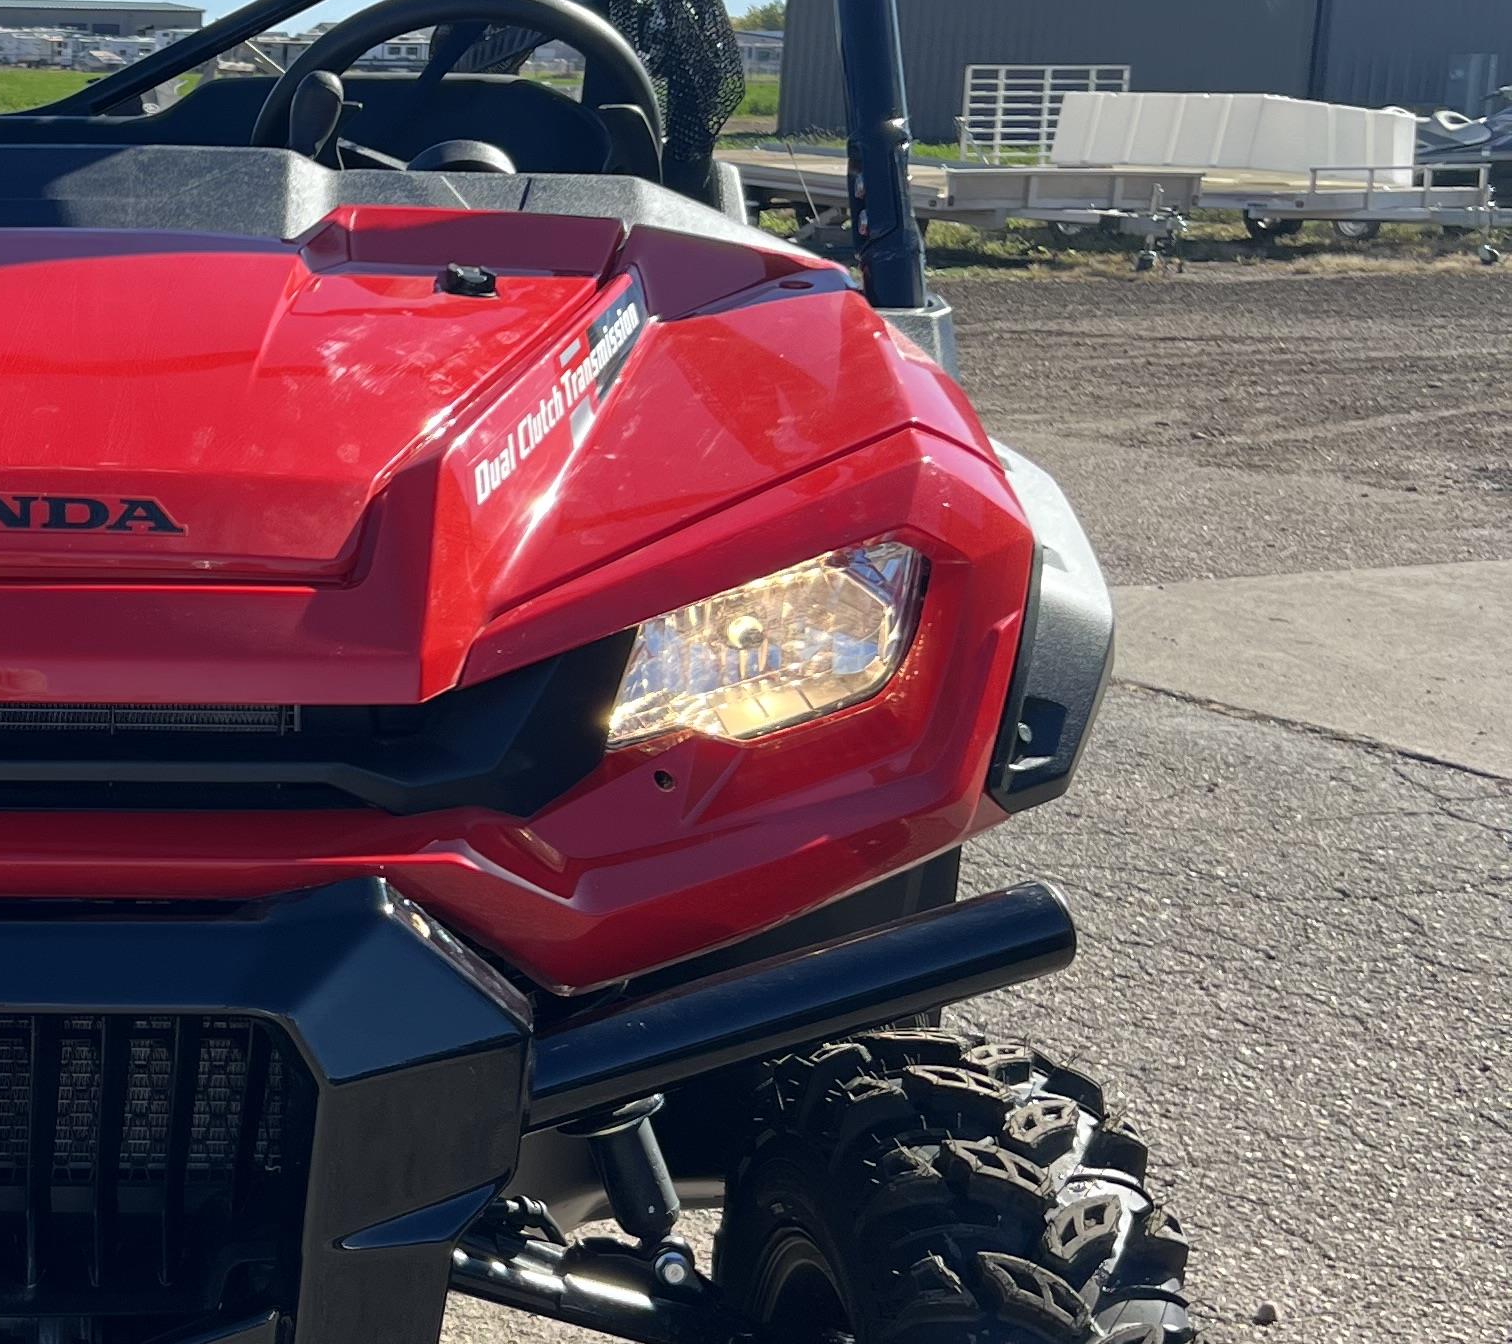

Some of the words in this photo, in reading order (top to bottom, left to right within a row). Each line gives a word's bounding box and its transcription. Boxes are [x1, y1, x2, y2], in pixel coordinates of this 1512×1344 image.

[474, 433, 517, 506] Dual
[517, 384, 565, 460] Clutch
[560, 301, 640, 408] Transmission
